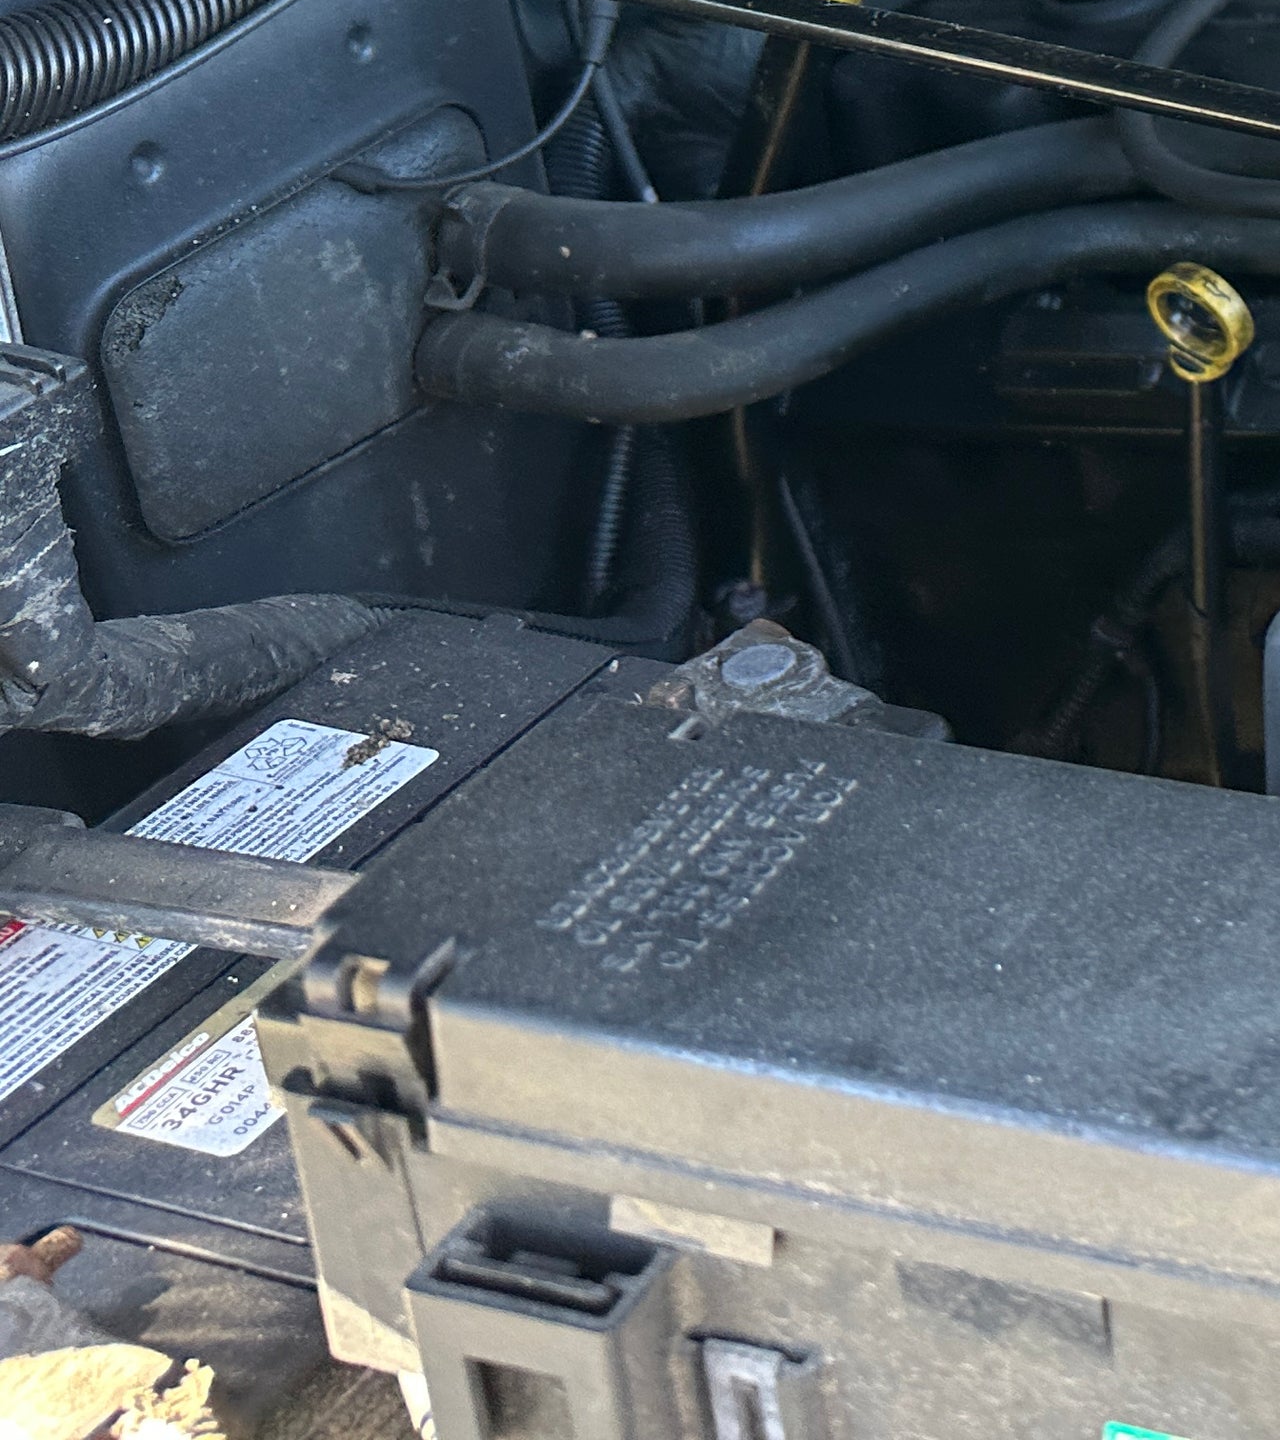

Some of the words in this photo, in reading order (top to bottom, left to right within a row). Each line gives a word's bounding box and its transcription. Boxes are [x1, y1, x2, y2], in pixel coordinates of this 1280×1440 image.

[115, 1032, 210, 1112] ACDelco
[162, 1065, 246, 1131] 34GHR
[208, 1084, 255, 1125] G014P
